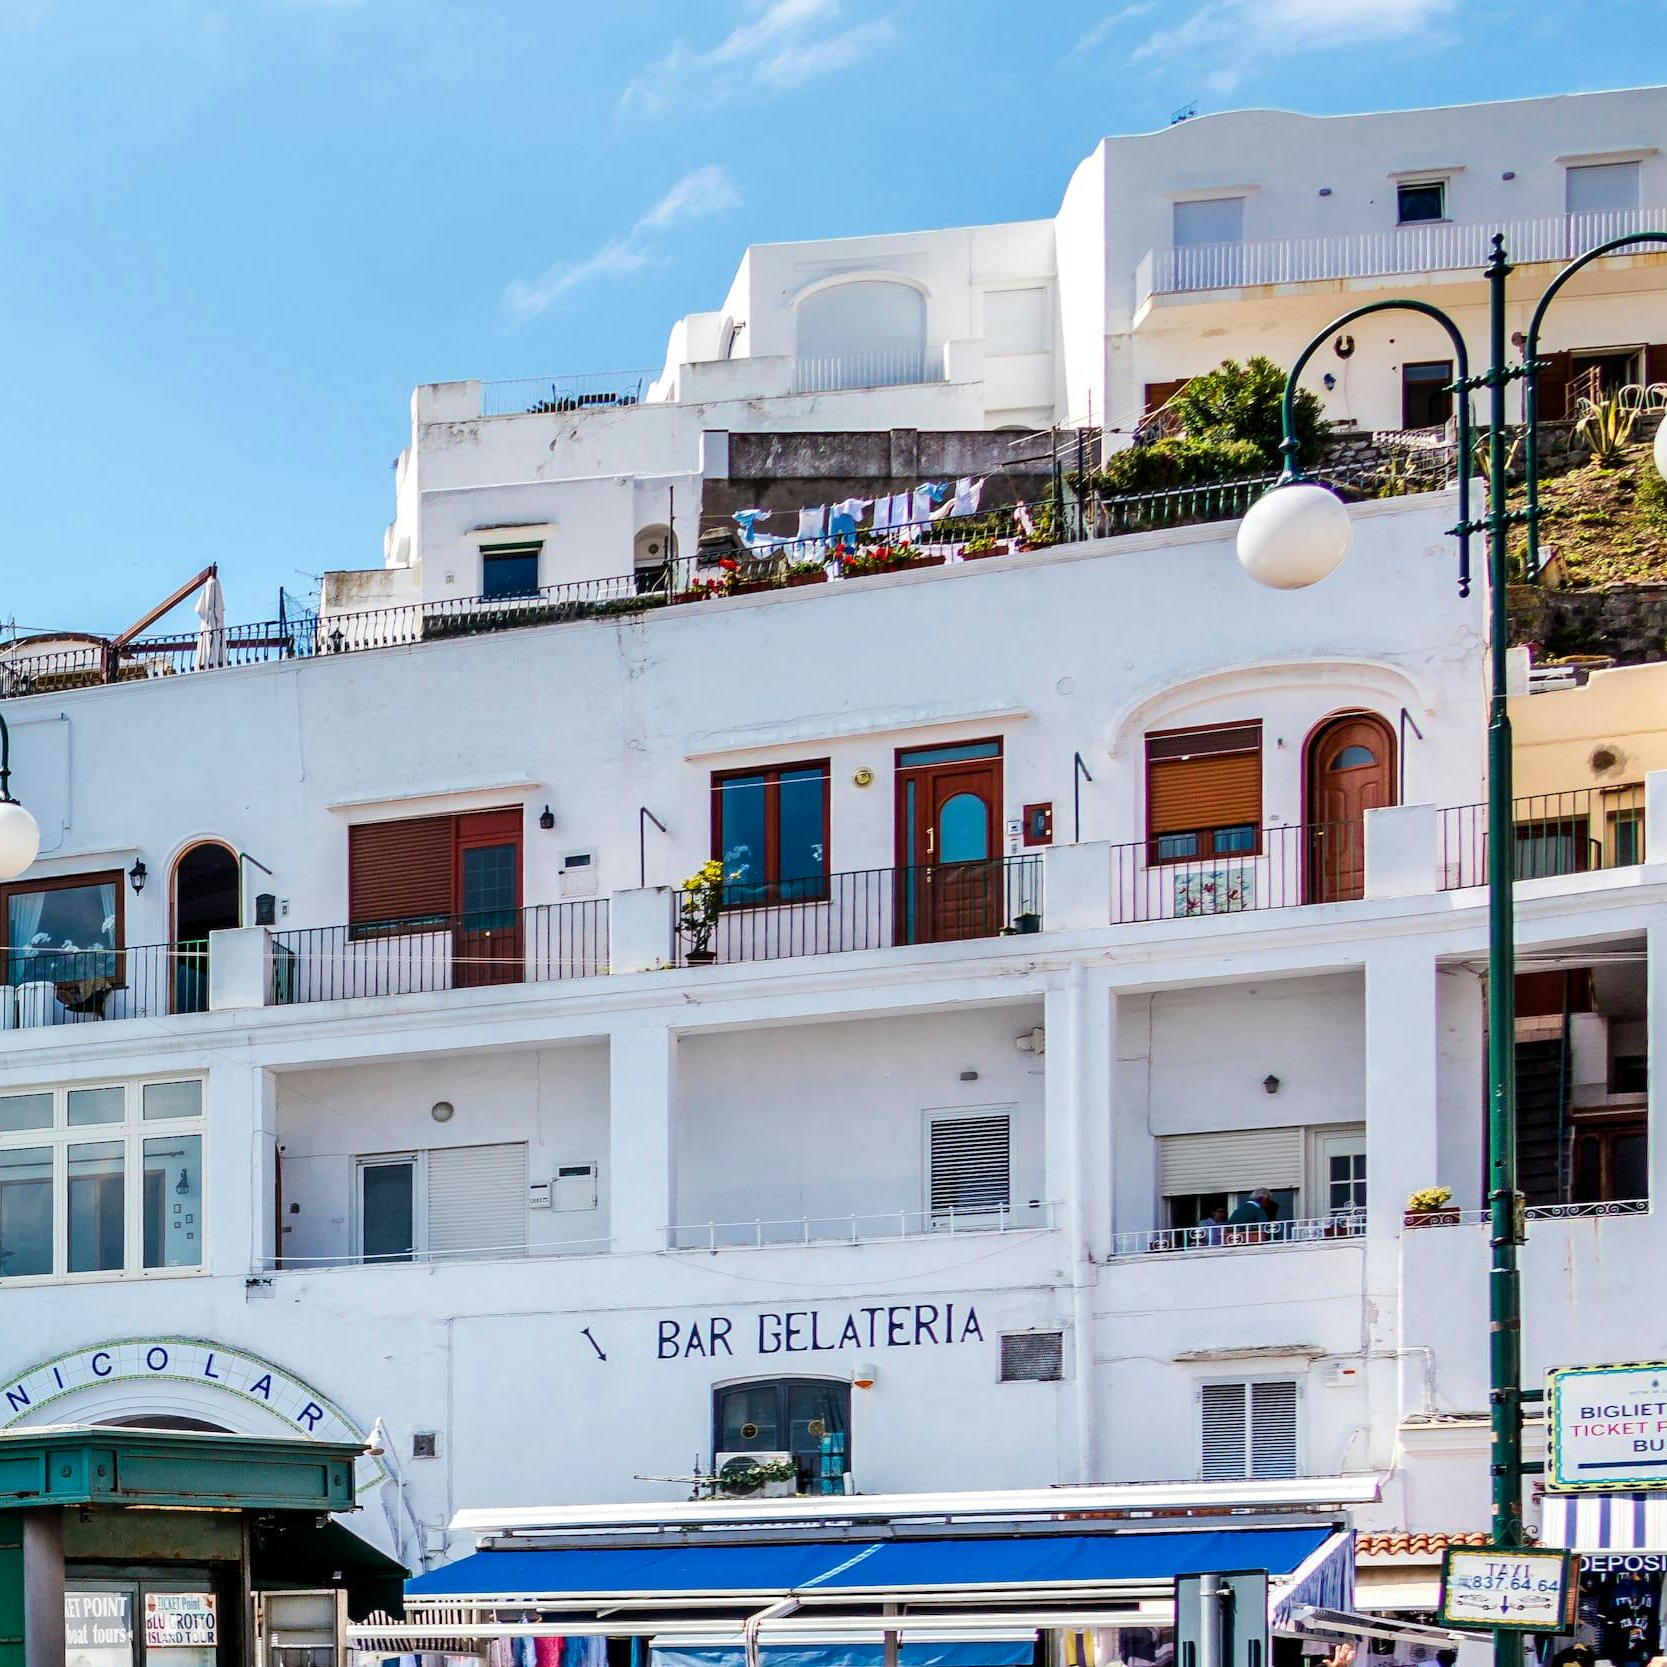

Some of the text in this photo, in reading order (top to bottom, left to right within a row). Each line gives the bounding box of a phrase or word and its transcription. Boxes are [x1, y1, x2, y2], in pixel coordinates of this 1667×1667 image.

[658, 1303, 985, 1360] BAR GELATERIA
[1571, 1421, 1648, 1438] TICKET
[1633, 1439, 1666, 1452] BU
[1580, 1555, 1667, 1572] DEPOSI
[84, 1596, 128, 1618] POINT
[93, 1624, 126, 1645] tours
[186, 1632, 215, 1644] TOUR
